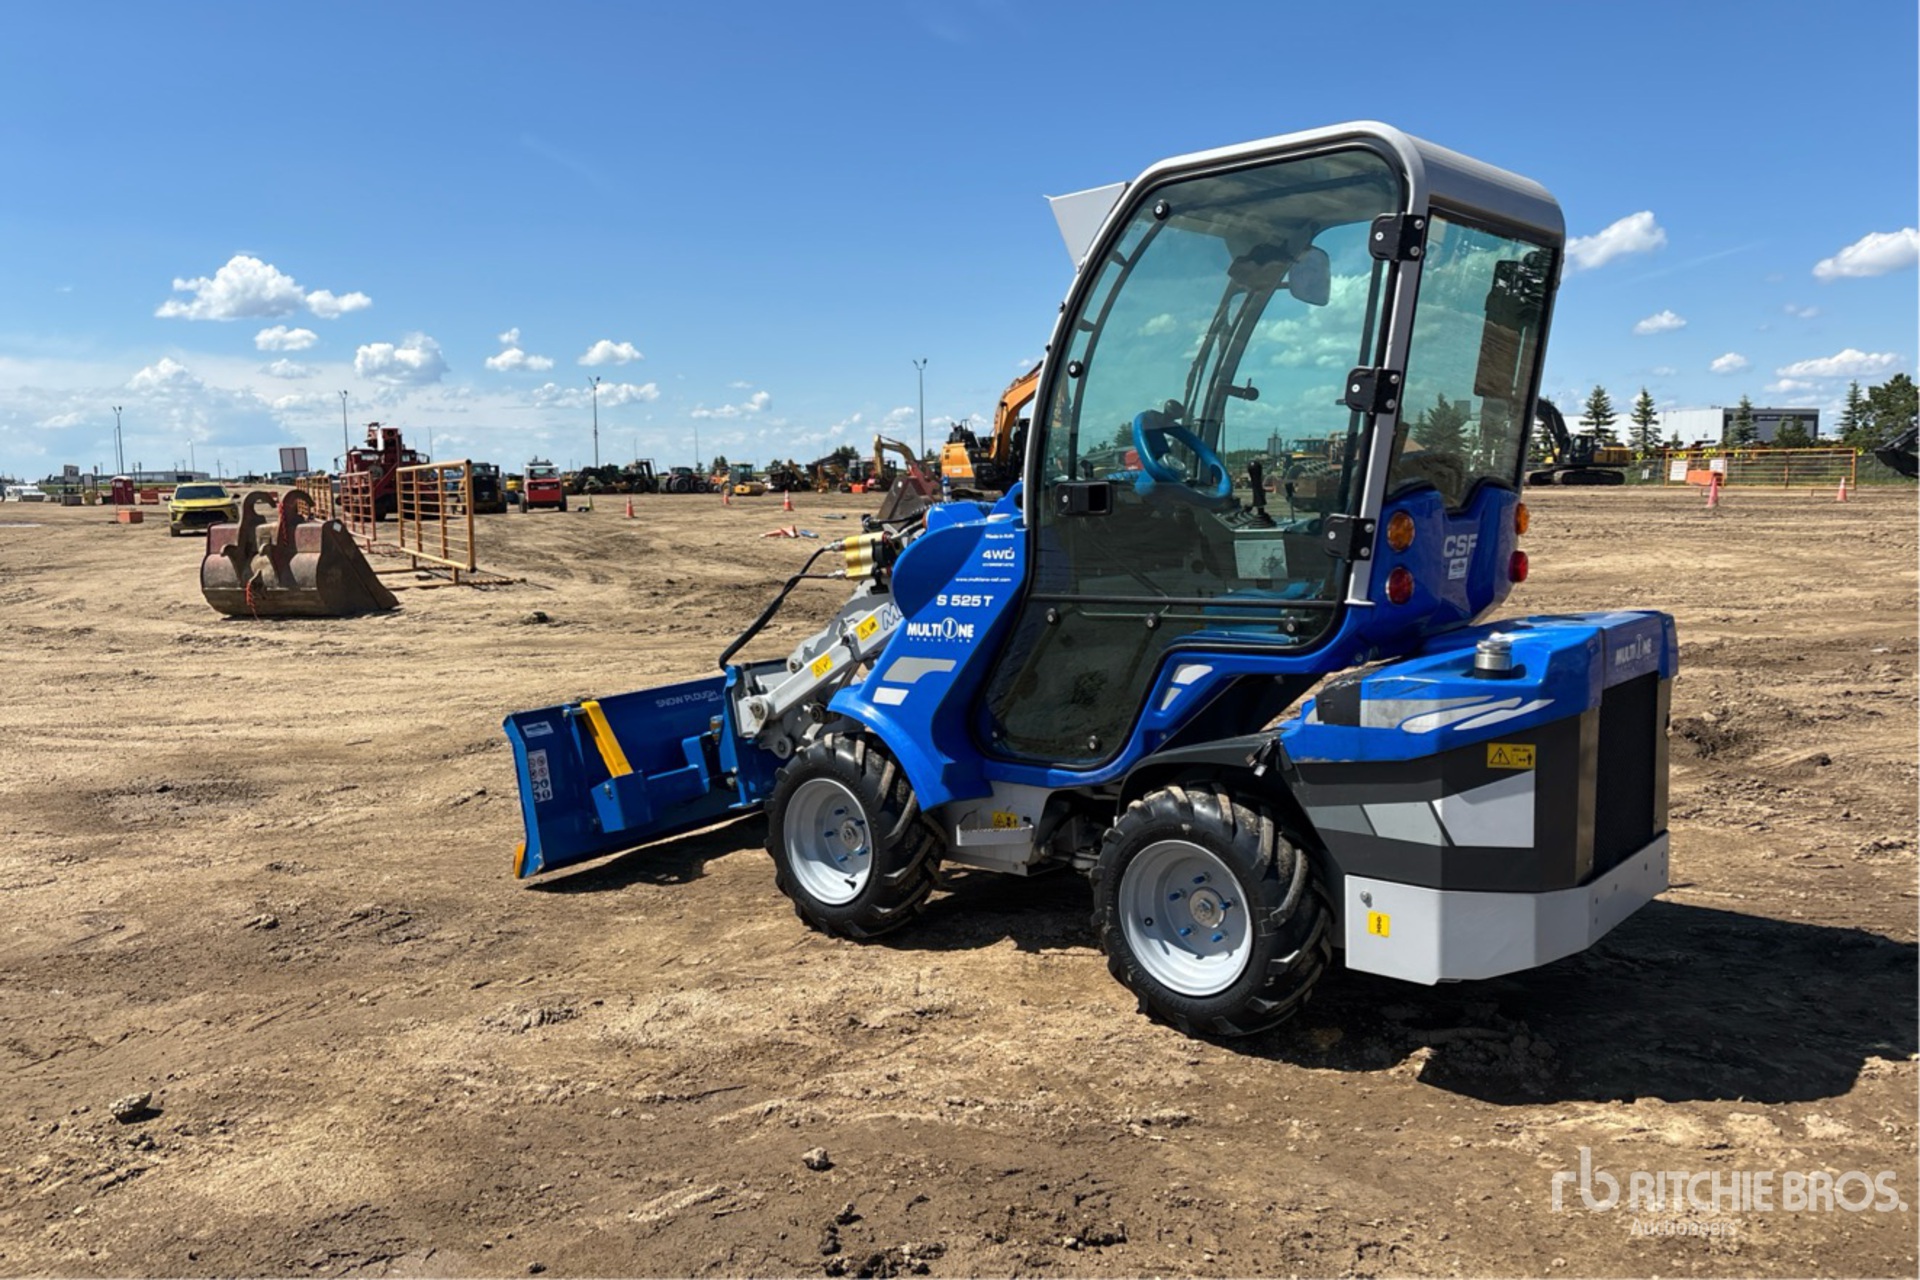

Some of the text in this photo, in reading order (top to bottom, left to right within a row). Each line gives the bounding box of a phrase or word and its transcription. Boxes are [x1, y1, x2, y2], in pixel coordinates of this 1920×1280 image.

[1443, 533, 1478, 558] CSF
[982, 549, 1015, 560] 4WD
[936, 594, 994, 608] S 525 T
